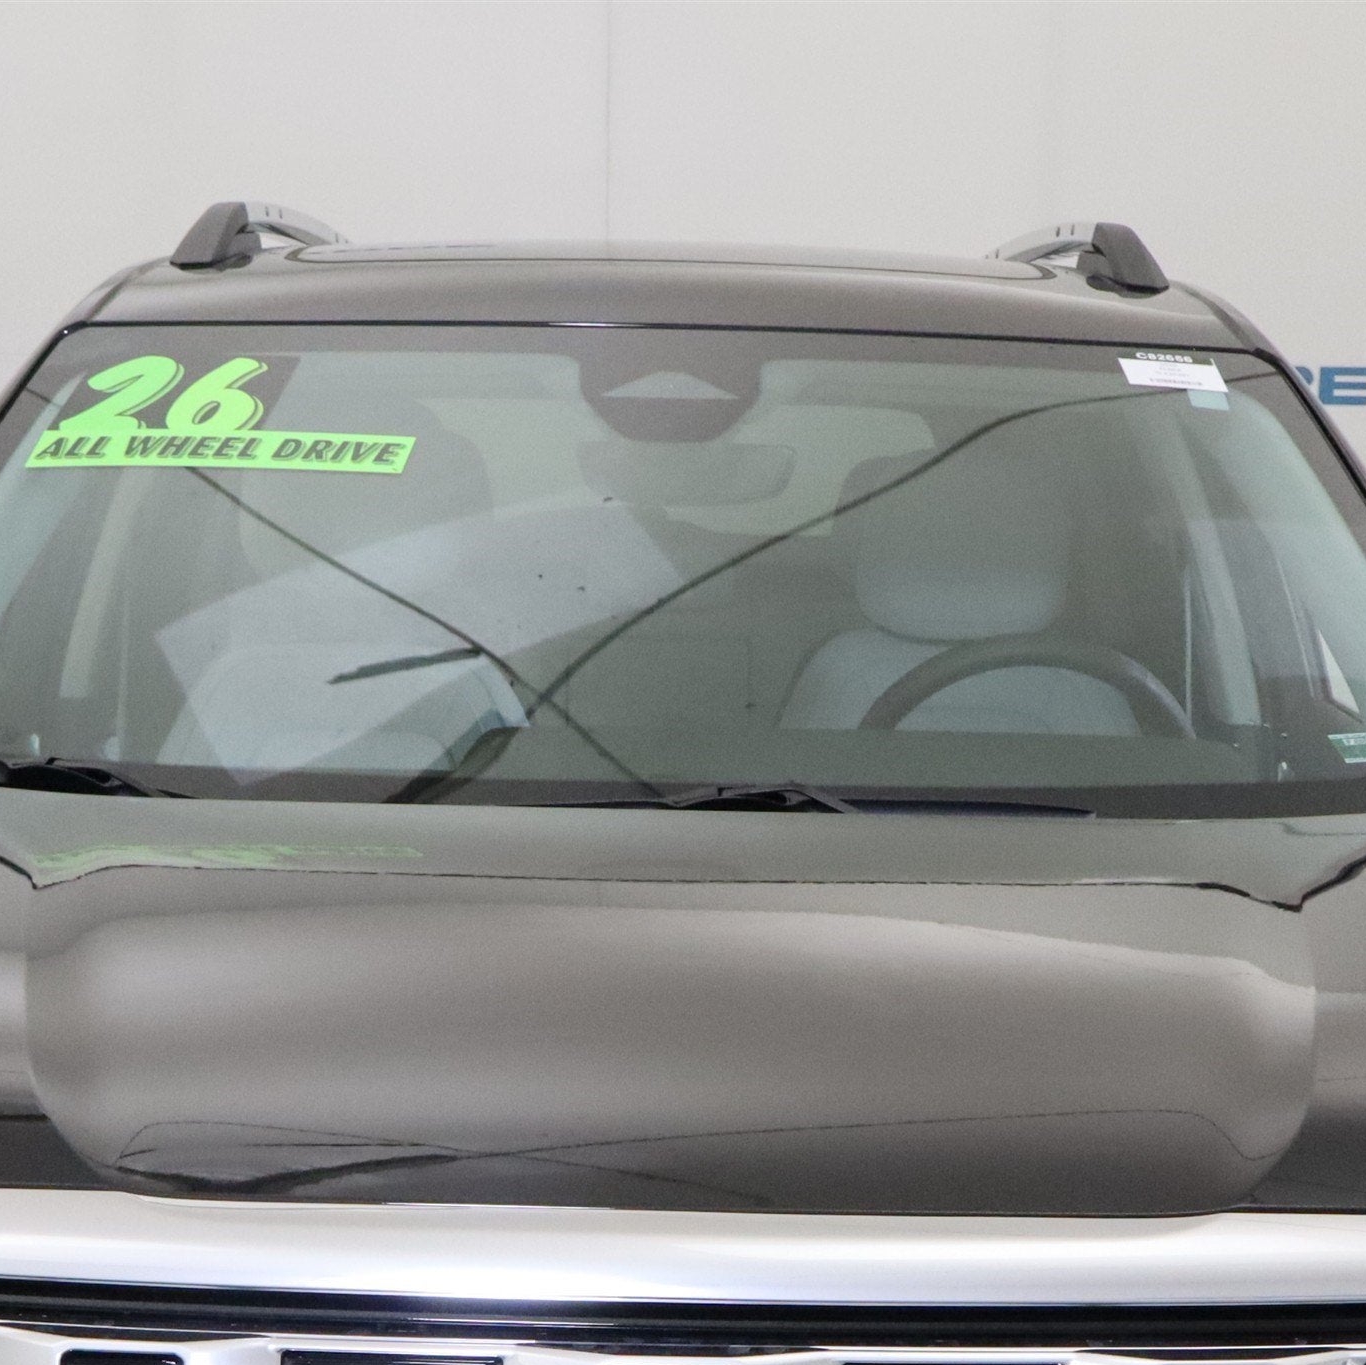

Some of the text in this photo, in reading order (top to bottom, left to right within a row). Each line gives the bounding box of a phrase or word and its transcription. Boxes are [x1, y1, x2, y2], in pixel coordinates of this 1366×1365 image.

[57, 355, 269, 431] 26
[36, 435, 406, 464] ALL WHEEL DRIVE
